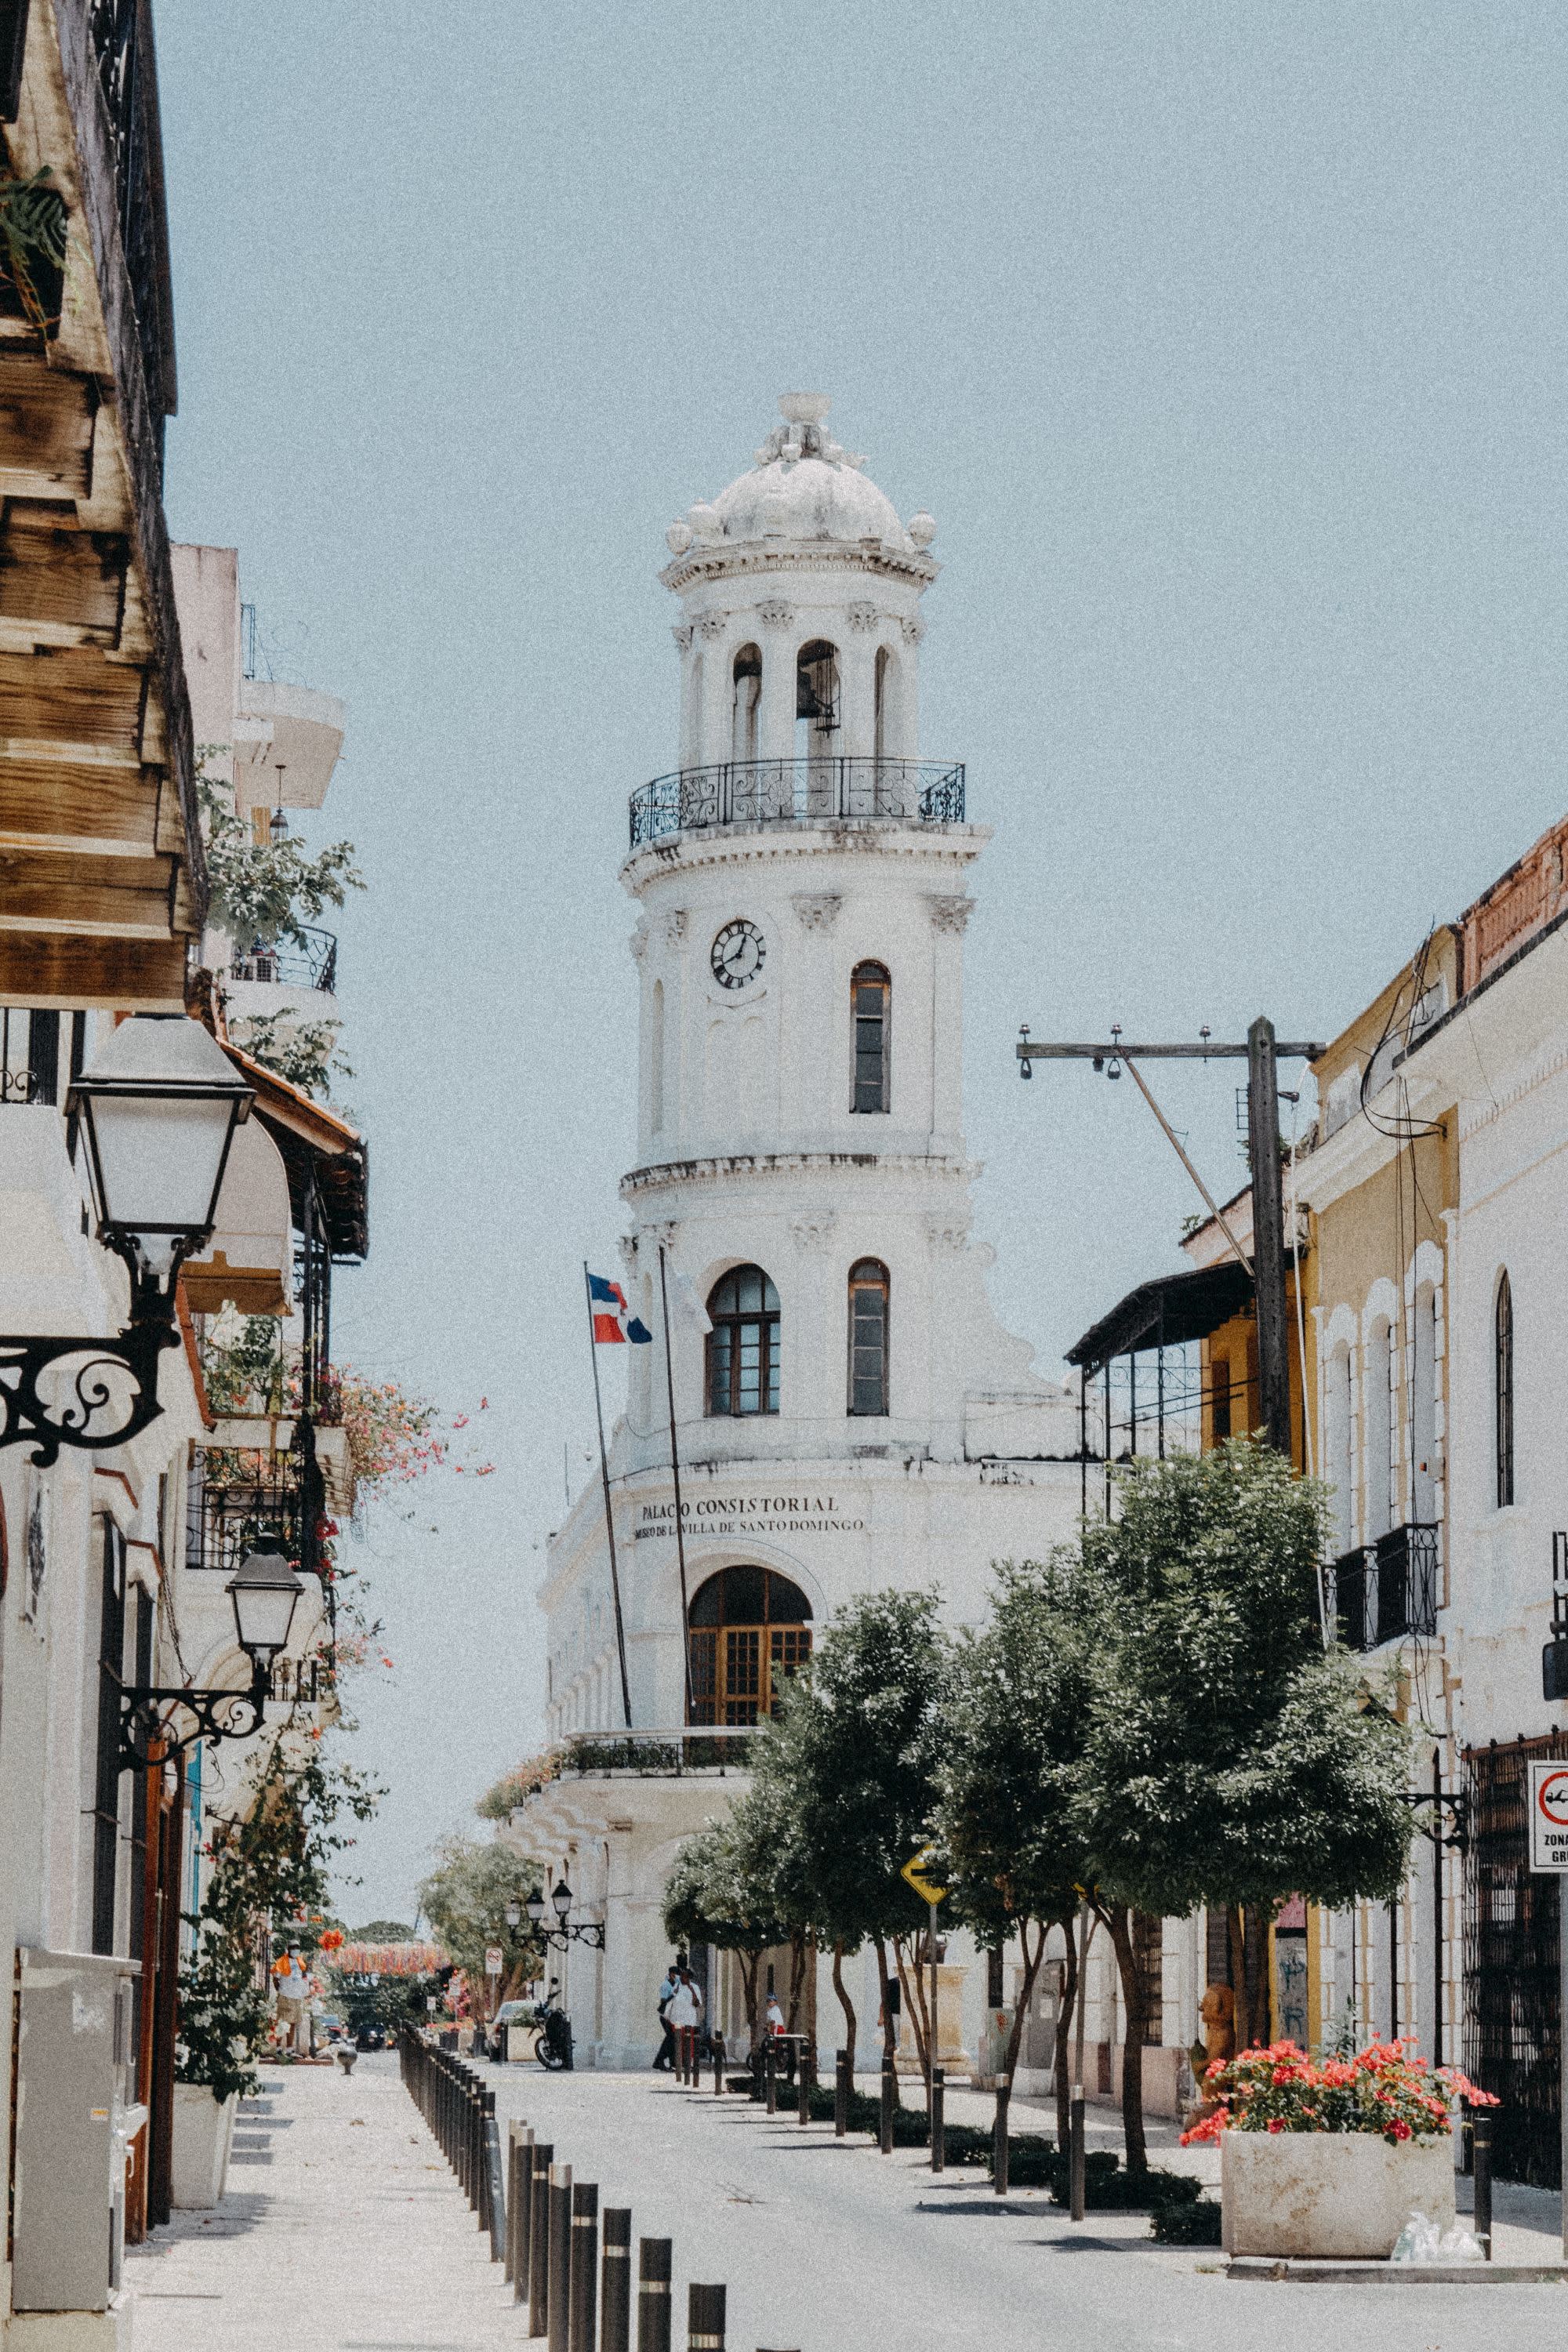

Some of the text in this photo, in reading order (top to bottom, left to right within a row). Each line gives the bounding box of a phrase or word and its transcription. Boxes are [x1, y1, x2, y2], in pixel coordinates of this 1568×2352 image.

[643, 1497, 838, 1521] PALACO CONSISTORIAL
[669, 1526, 679, 1537] L
[681, 1523, 714, 1534] VILLA
[719, 1522, 735, 1534] DE
[740, 1520, 786, 1532] SANTO
[789, 1519, 864, 1531] DOMINGO
[1552, 1850, 1568, 1863] GR
